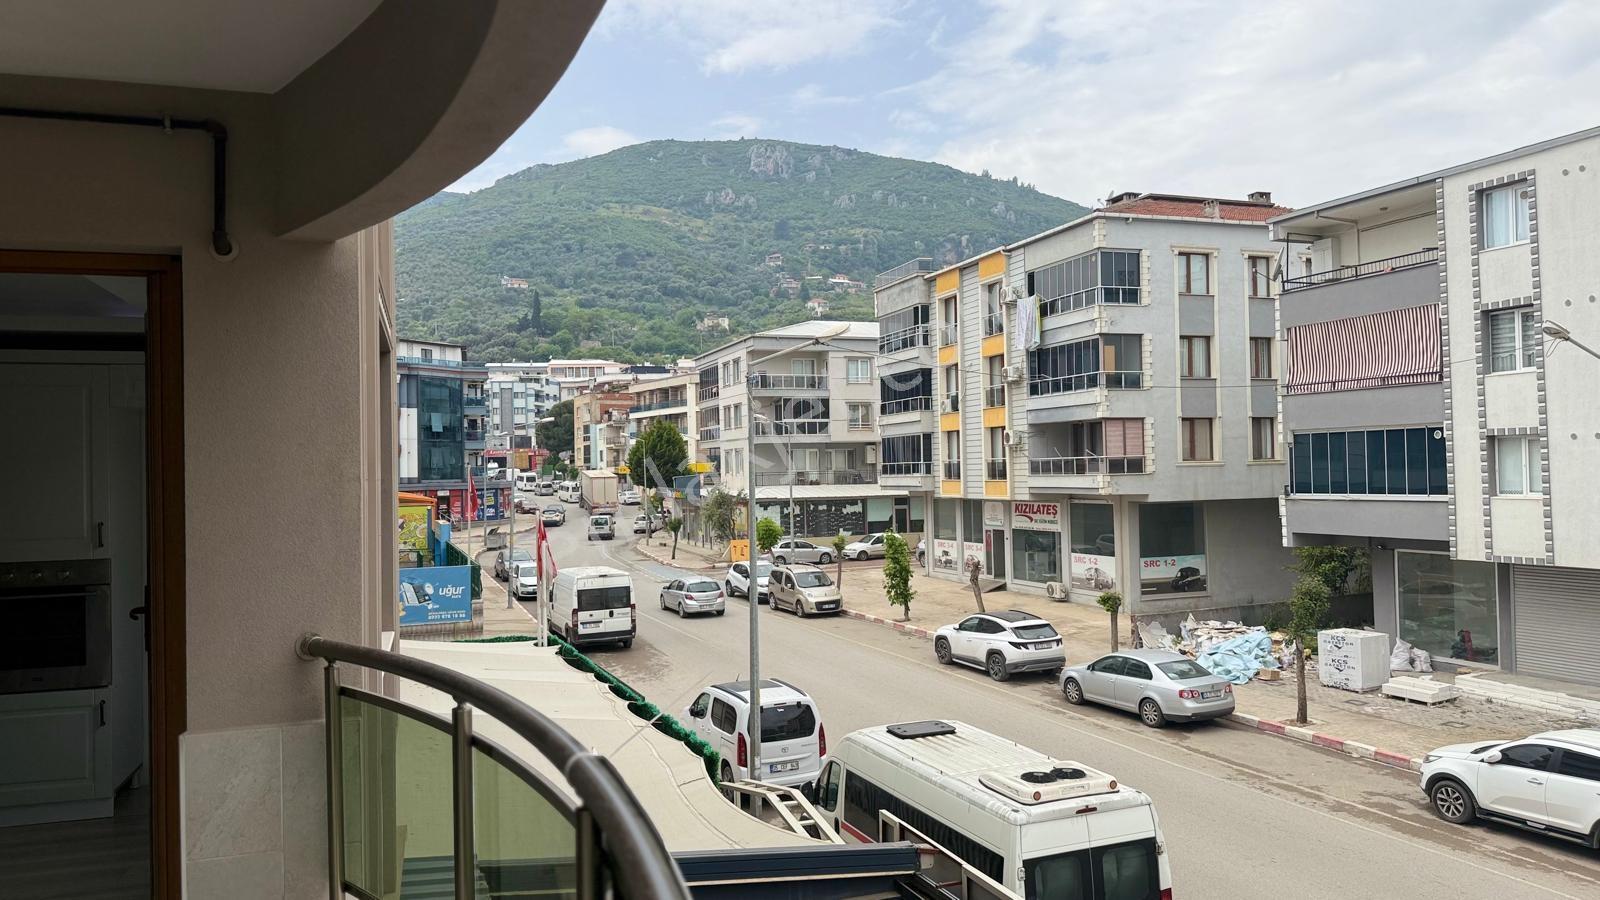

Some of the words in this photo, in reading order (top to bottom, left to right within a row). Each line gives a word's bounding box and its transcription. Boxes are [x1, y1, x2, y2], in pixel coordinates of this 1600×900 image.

[1014, 503, 1058, 519] KIZILATEŞ
[1073, 555, 1087, 564] SRC
[1088, 557, 1098, 565] 1-2
[1143, 560, 1161, 568] SRC
[1164, 559, 1176, 567] 1-2
[439, 584, 465, 597] uğur
